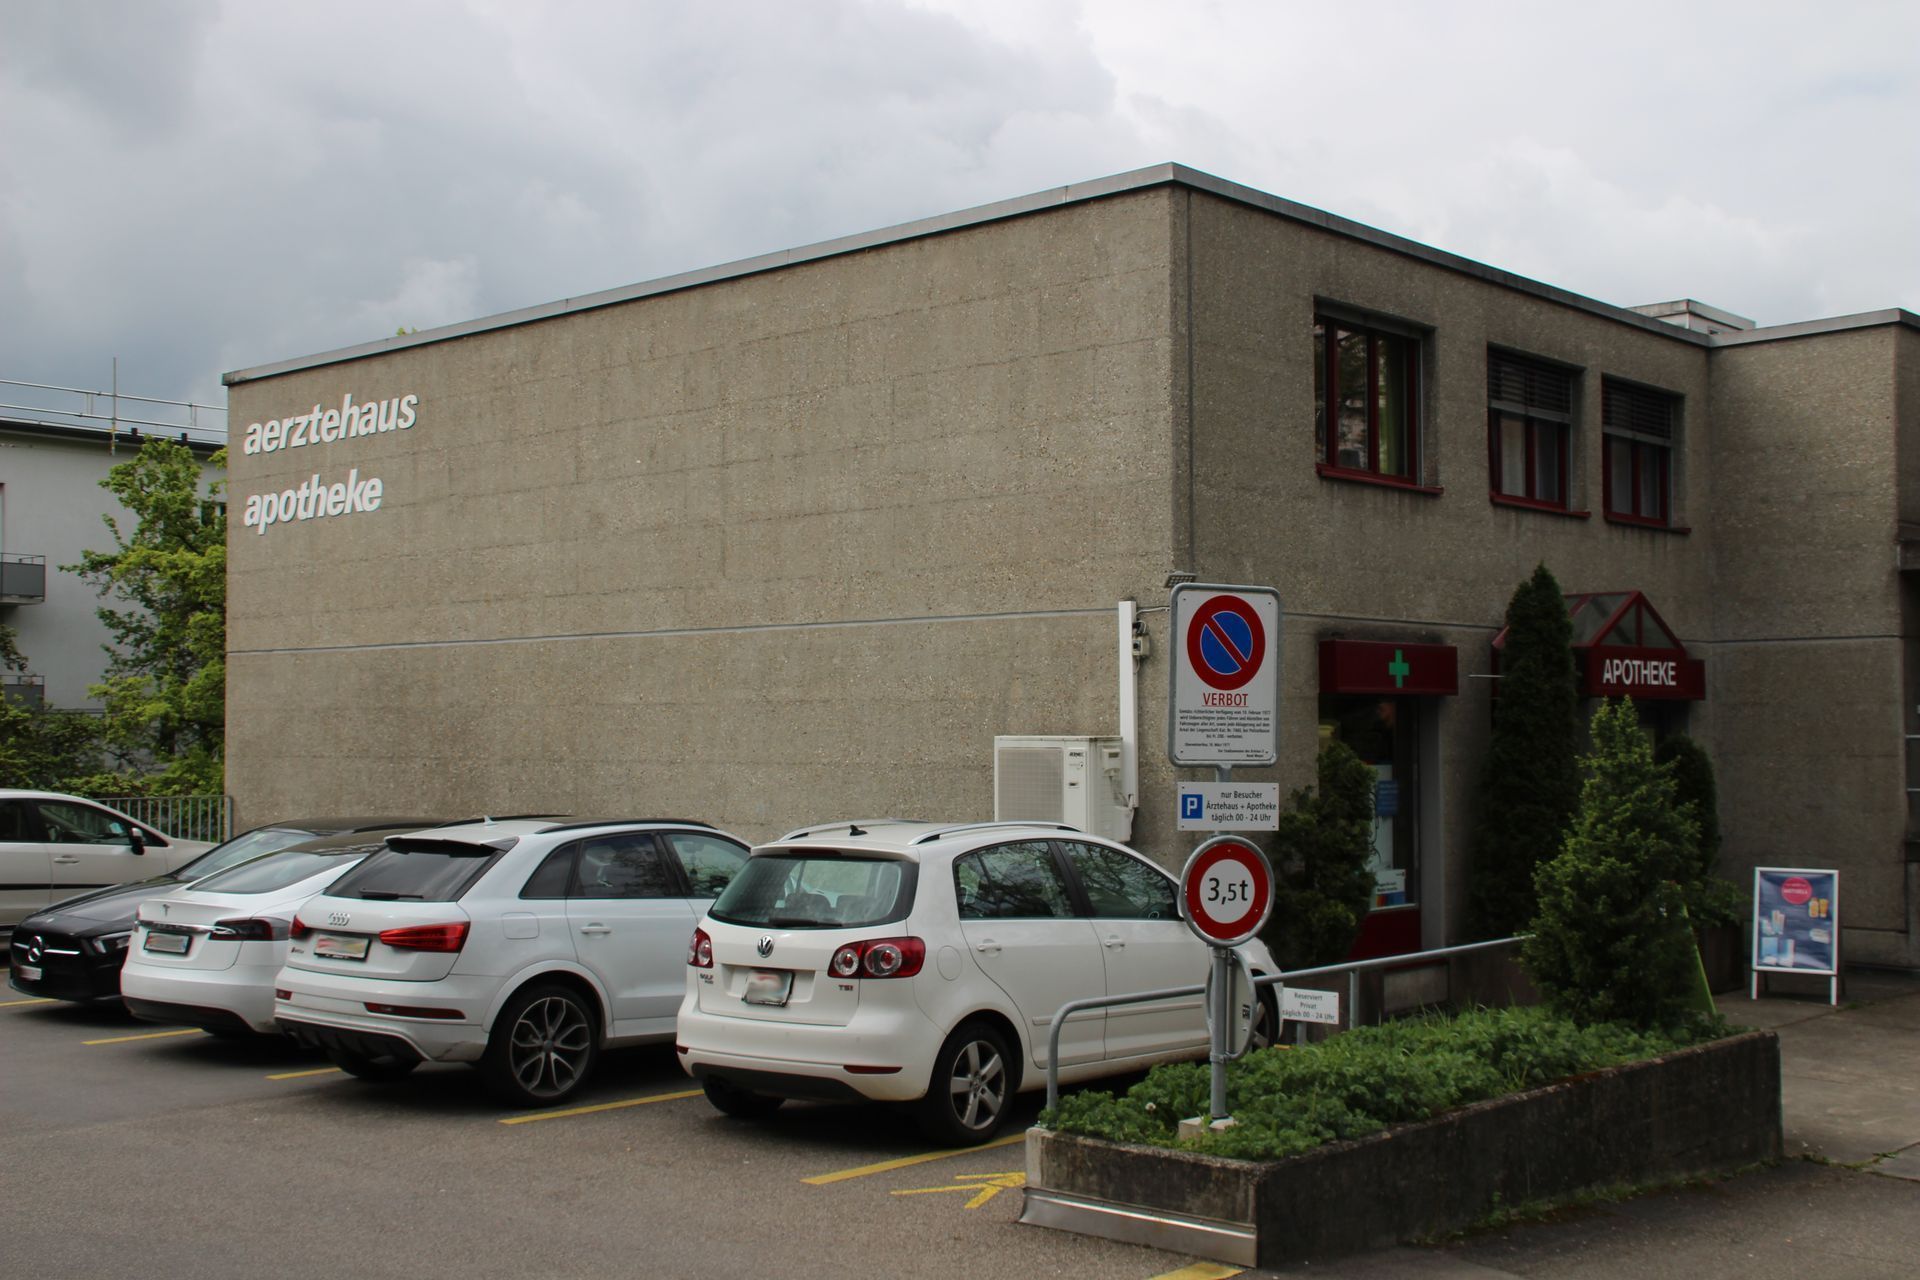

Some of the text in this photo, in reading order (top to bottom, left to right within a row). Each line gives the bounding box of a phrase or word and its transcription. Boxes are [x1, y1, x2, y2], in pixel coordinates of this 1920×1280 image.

[243, 393, 419, 456] aerztehaus
[243, 468, 384, 536] apotheke
[1602, 658, 1677, 686] APOTHEKE
[1202, 692, 1249, 706] VERBOT
[1220, 790, 1263, 799] nur Besucher
[1206, 800, 1239, 810] Ärztehaus
[1246, 801, 1277, 812] Apotheke
[1211, 812, 1234, 823] täglich
[1235, 813, 1244, 821] 00
[1250, 813, 1258, 821] 24
[1259, 813, 1272, 821] Uhr
[1294, 992, 1323, 1001] Reserviert
